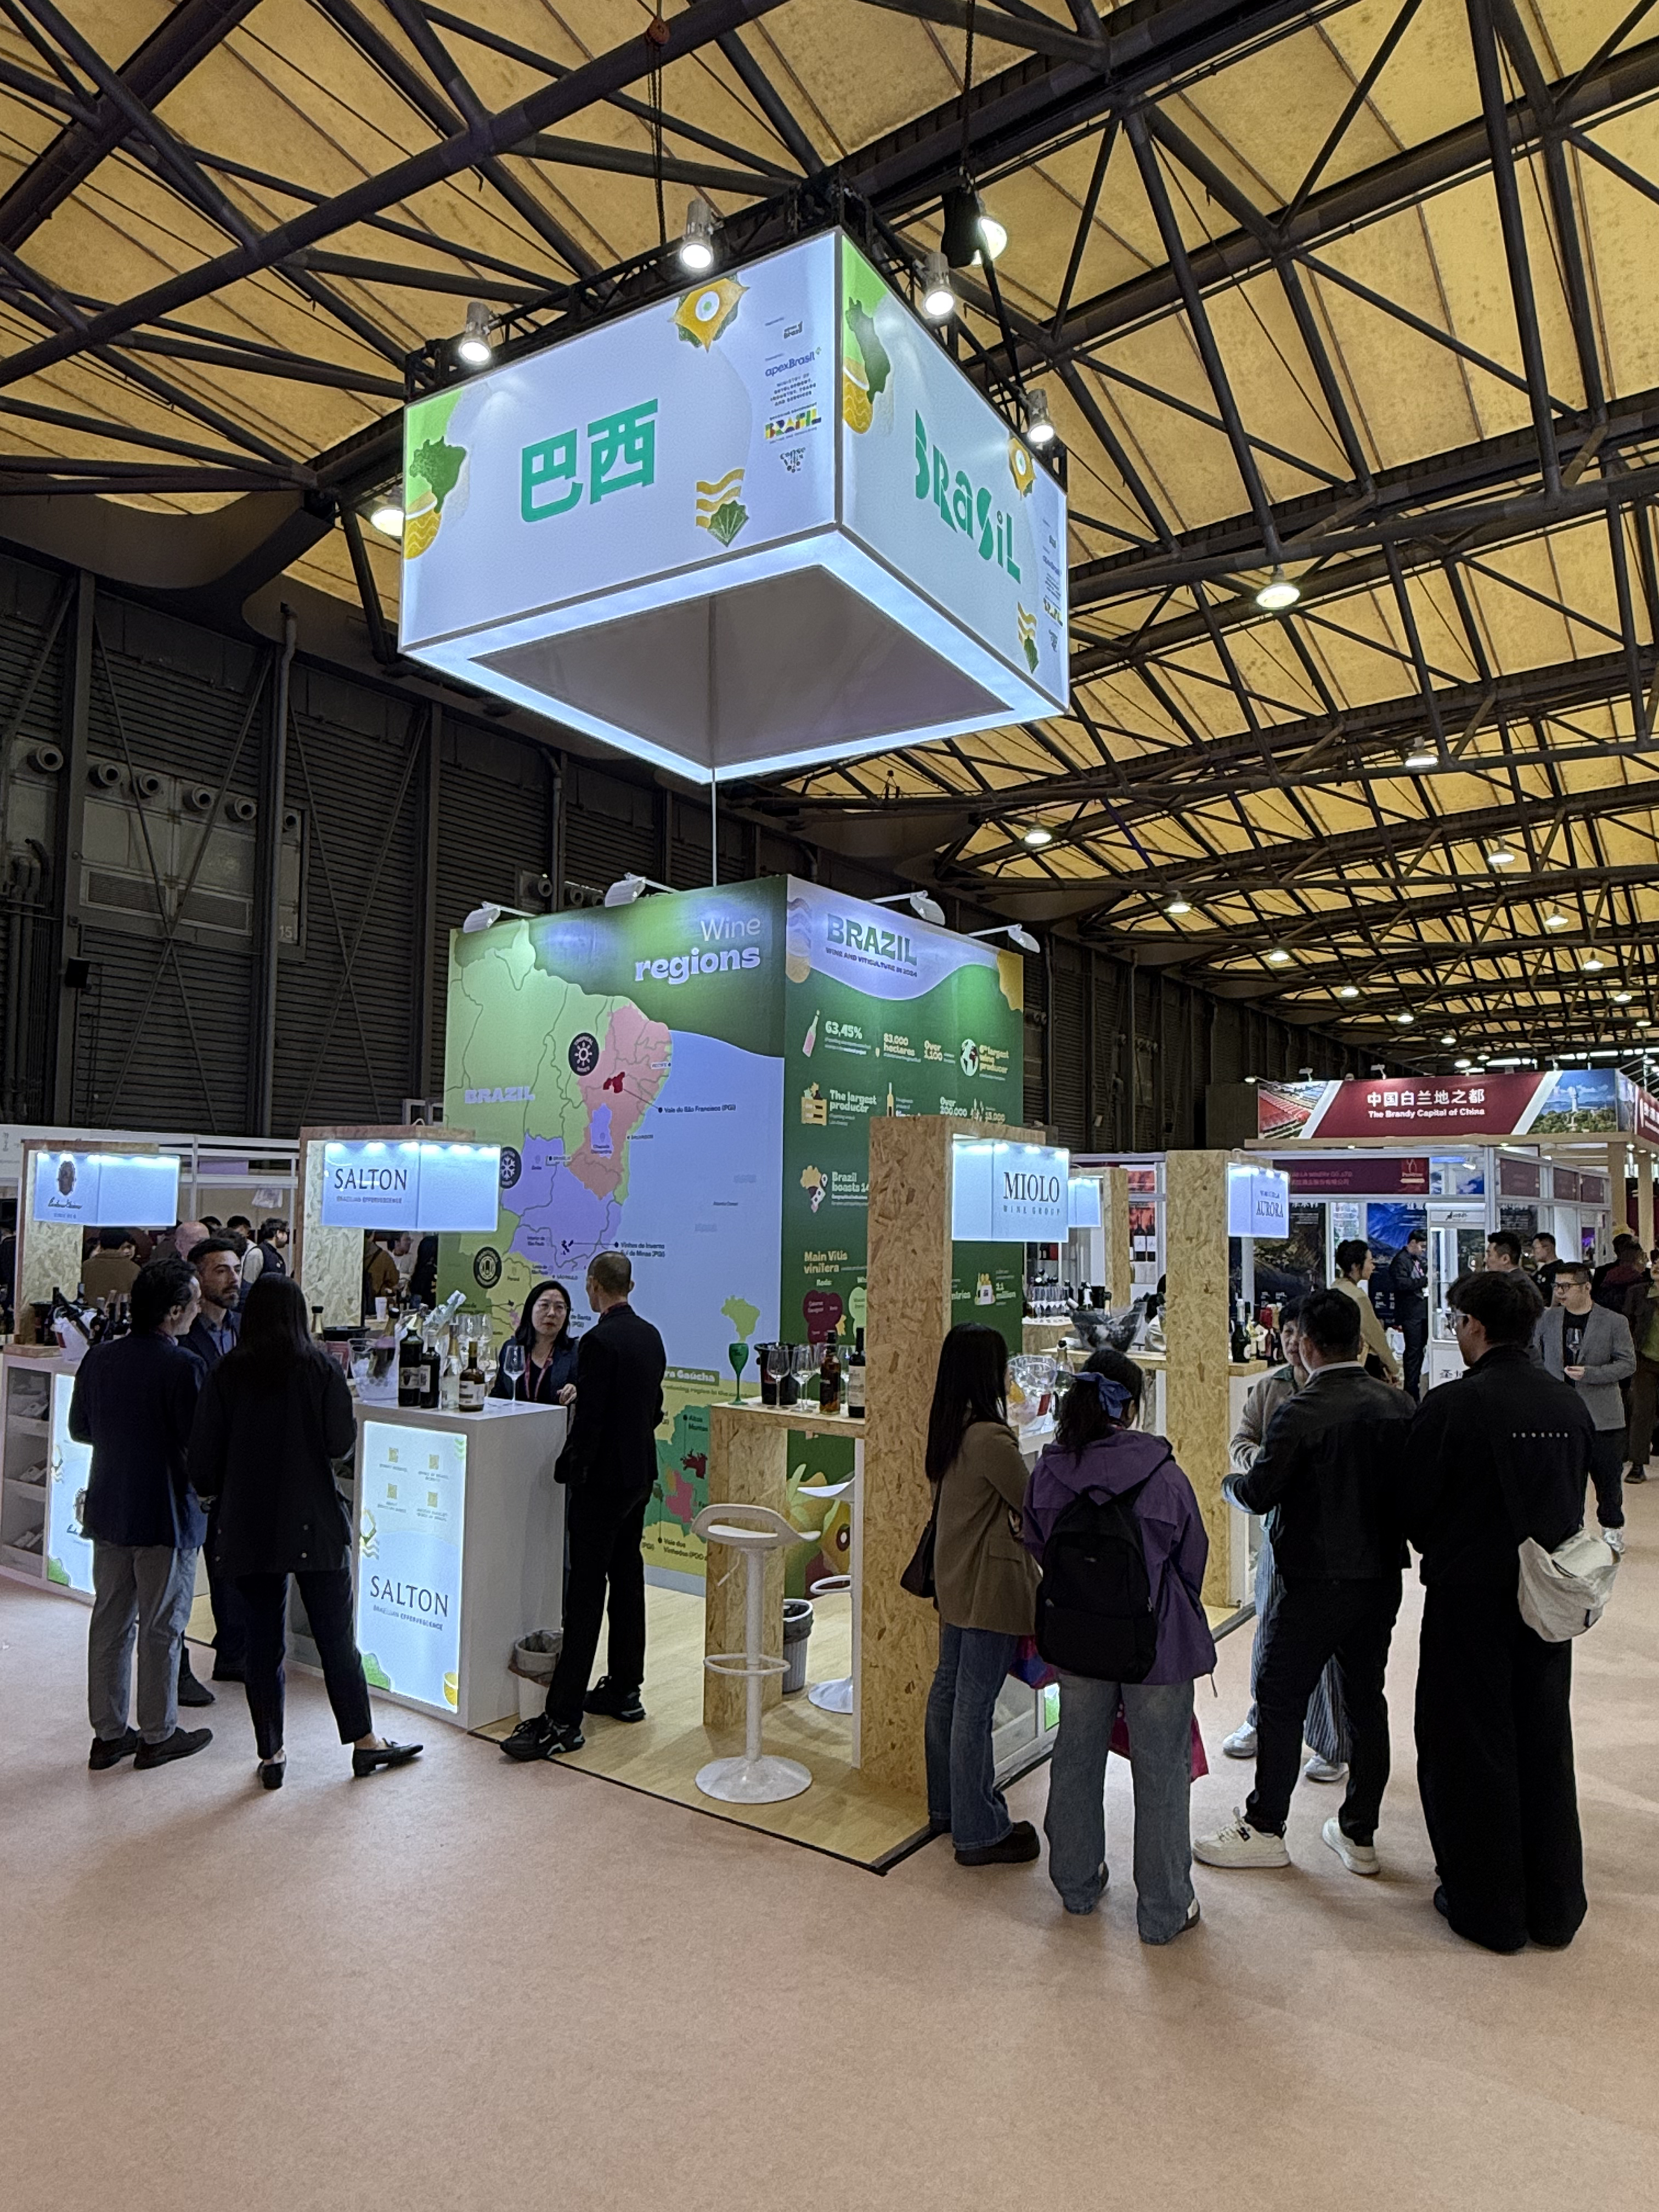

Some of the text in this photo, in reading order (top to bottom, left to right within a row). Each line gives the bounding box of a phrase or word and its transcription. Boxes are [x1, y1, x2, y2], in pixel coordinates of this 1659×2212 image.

[765, 352, 815, 376] apexBrasil
[522, 398, 658, 522] 巴西
[700, 916, 761, 941] Wine
[827, 913, 917, 966] BRAZIL
[635, 947, 761, 985] regions
[826, 947, 843, 958] WINE
[844, 952, 857, 961] AND
[858, 956, 895, 972] VITICULTURE
[825, 1021, 862, 1040] 63,45%
[884, 1042, 915, 1056] hectares
[924, 1040, 941, 1052] Over
[465, 1086, 535, 1104] BRAZIL
[830, 1089, 877, 1105] The largest
[940, 1097, 956, 1107] Over
[1368, 1088, 1485, 1107] 中国白兰地之都
[830, 1100, 870, 1113] producer
[1385, 1110, 1415, 1119] Brandy
[1417, 1109, 1447, 1118] Capital
[1459, 1107, 1485, 1116] China
[334, 1169, 407, 1190] SALTON
[832, 1171, 856, 1182] Brazil
[832, 1182, 860, 1193] boasts
[1003, 1172, 1059, 1203] MIOLO
[1003, 1205, 1060, 1215] WINE GROUP
[804, 1250, 848, 1262] Main Vitis
[804, 1263, 839, 1274] vinifera
[677, 1369, 715, 1383] Gaúcha
[370, 1575, 448, 1617] SALTON
